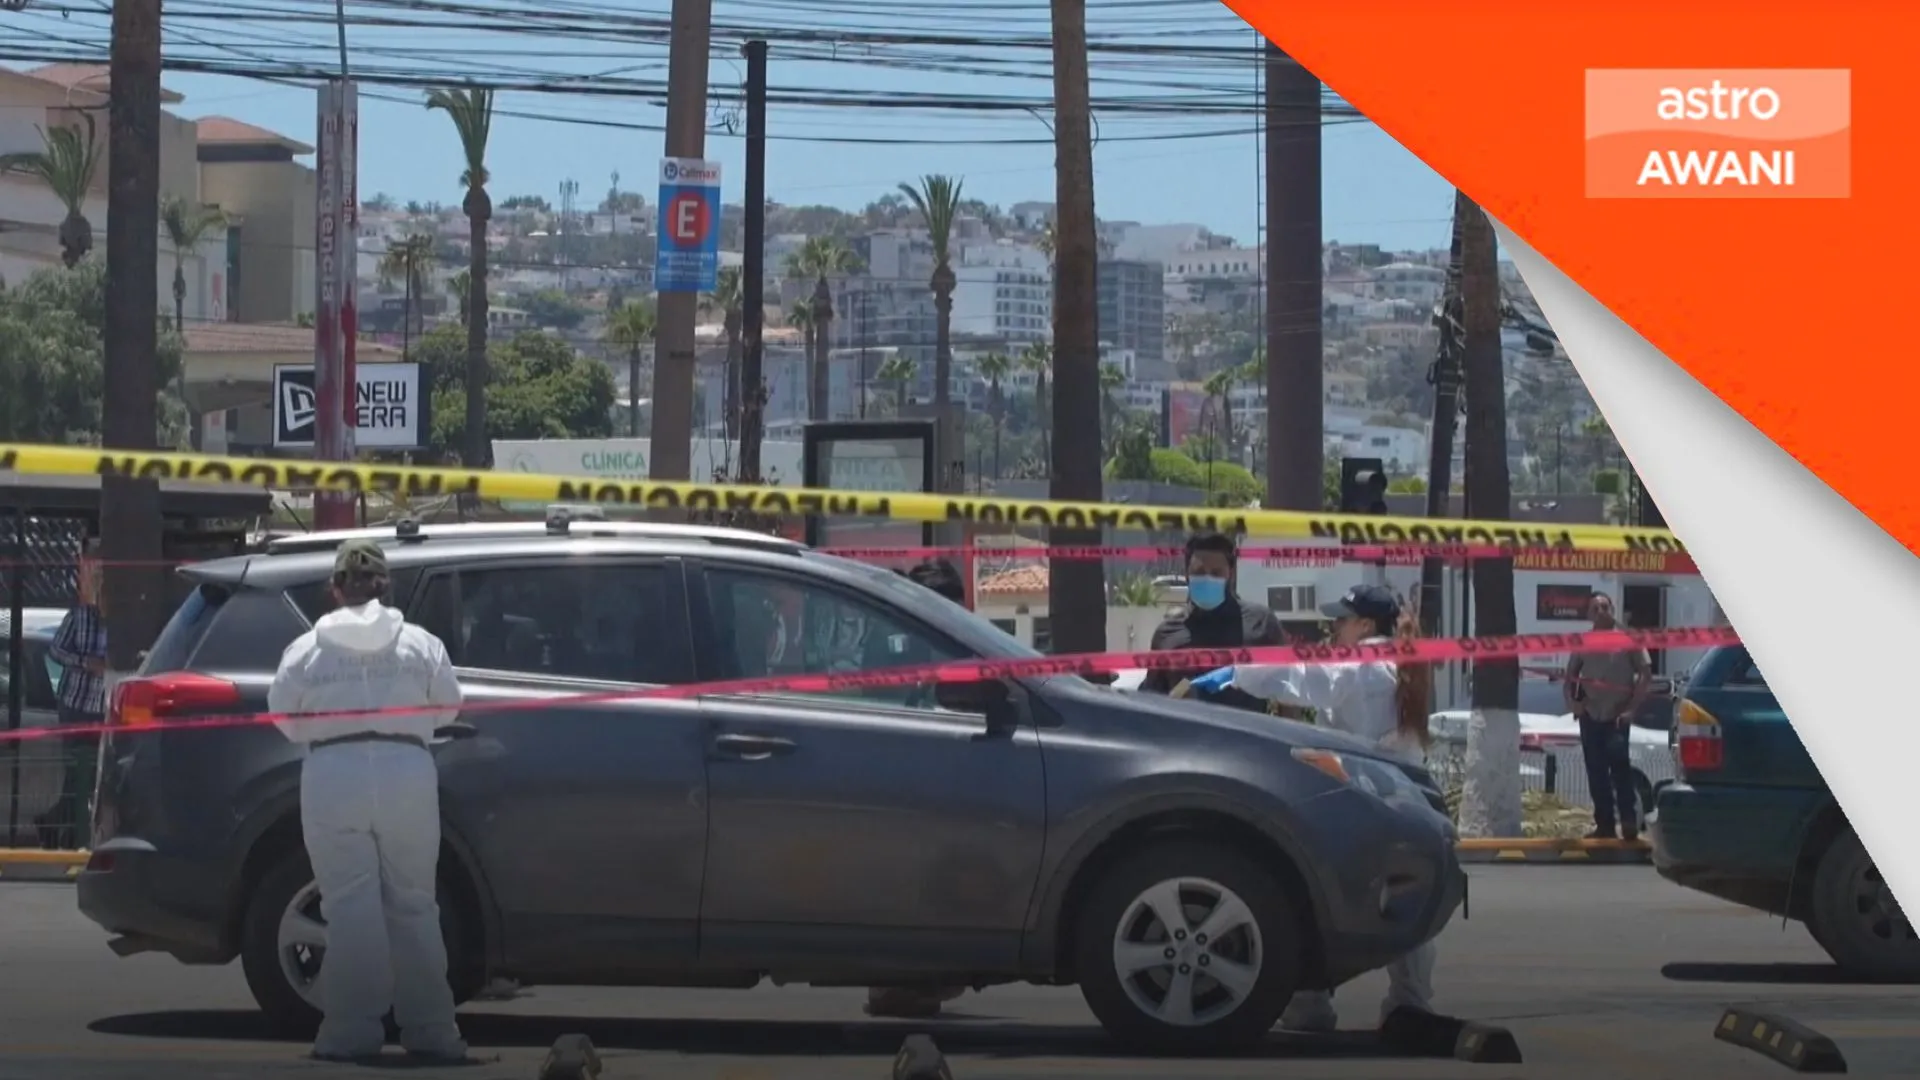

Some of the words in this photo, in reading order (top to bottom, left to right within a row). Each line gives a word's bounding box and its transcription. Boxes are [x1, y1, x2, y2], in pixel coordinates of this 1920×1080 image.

[677, 200, 698, 238] E
[356, 381, 406, 404] NEW
[356, 405, 406, 428] ERA
[1622, 553, 1666, 571] CASINO
